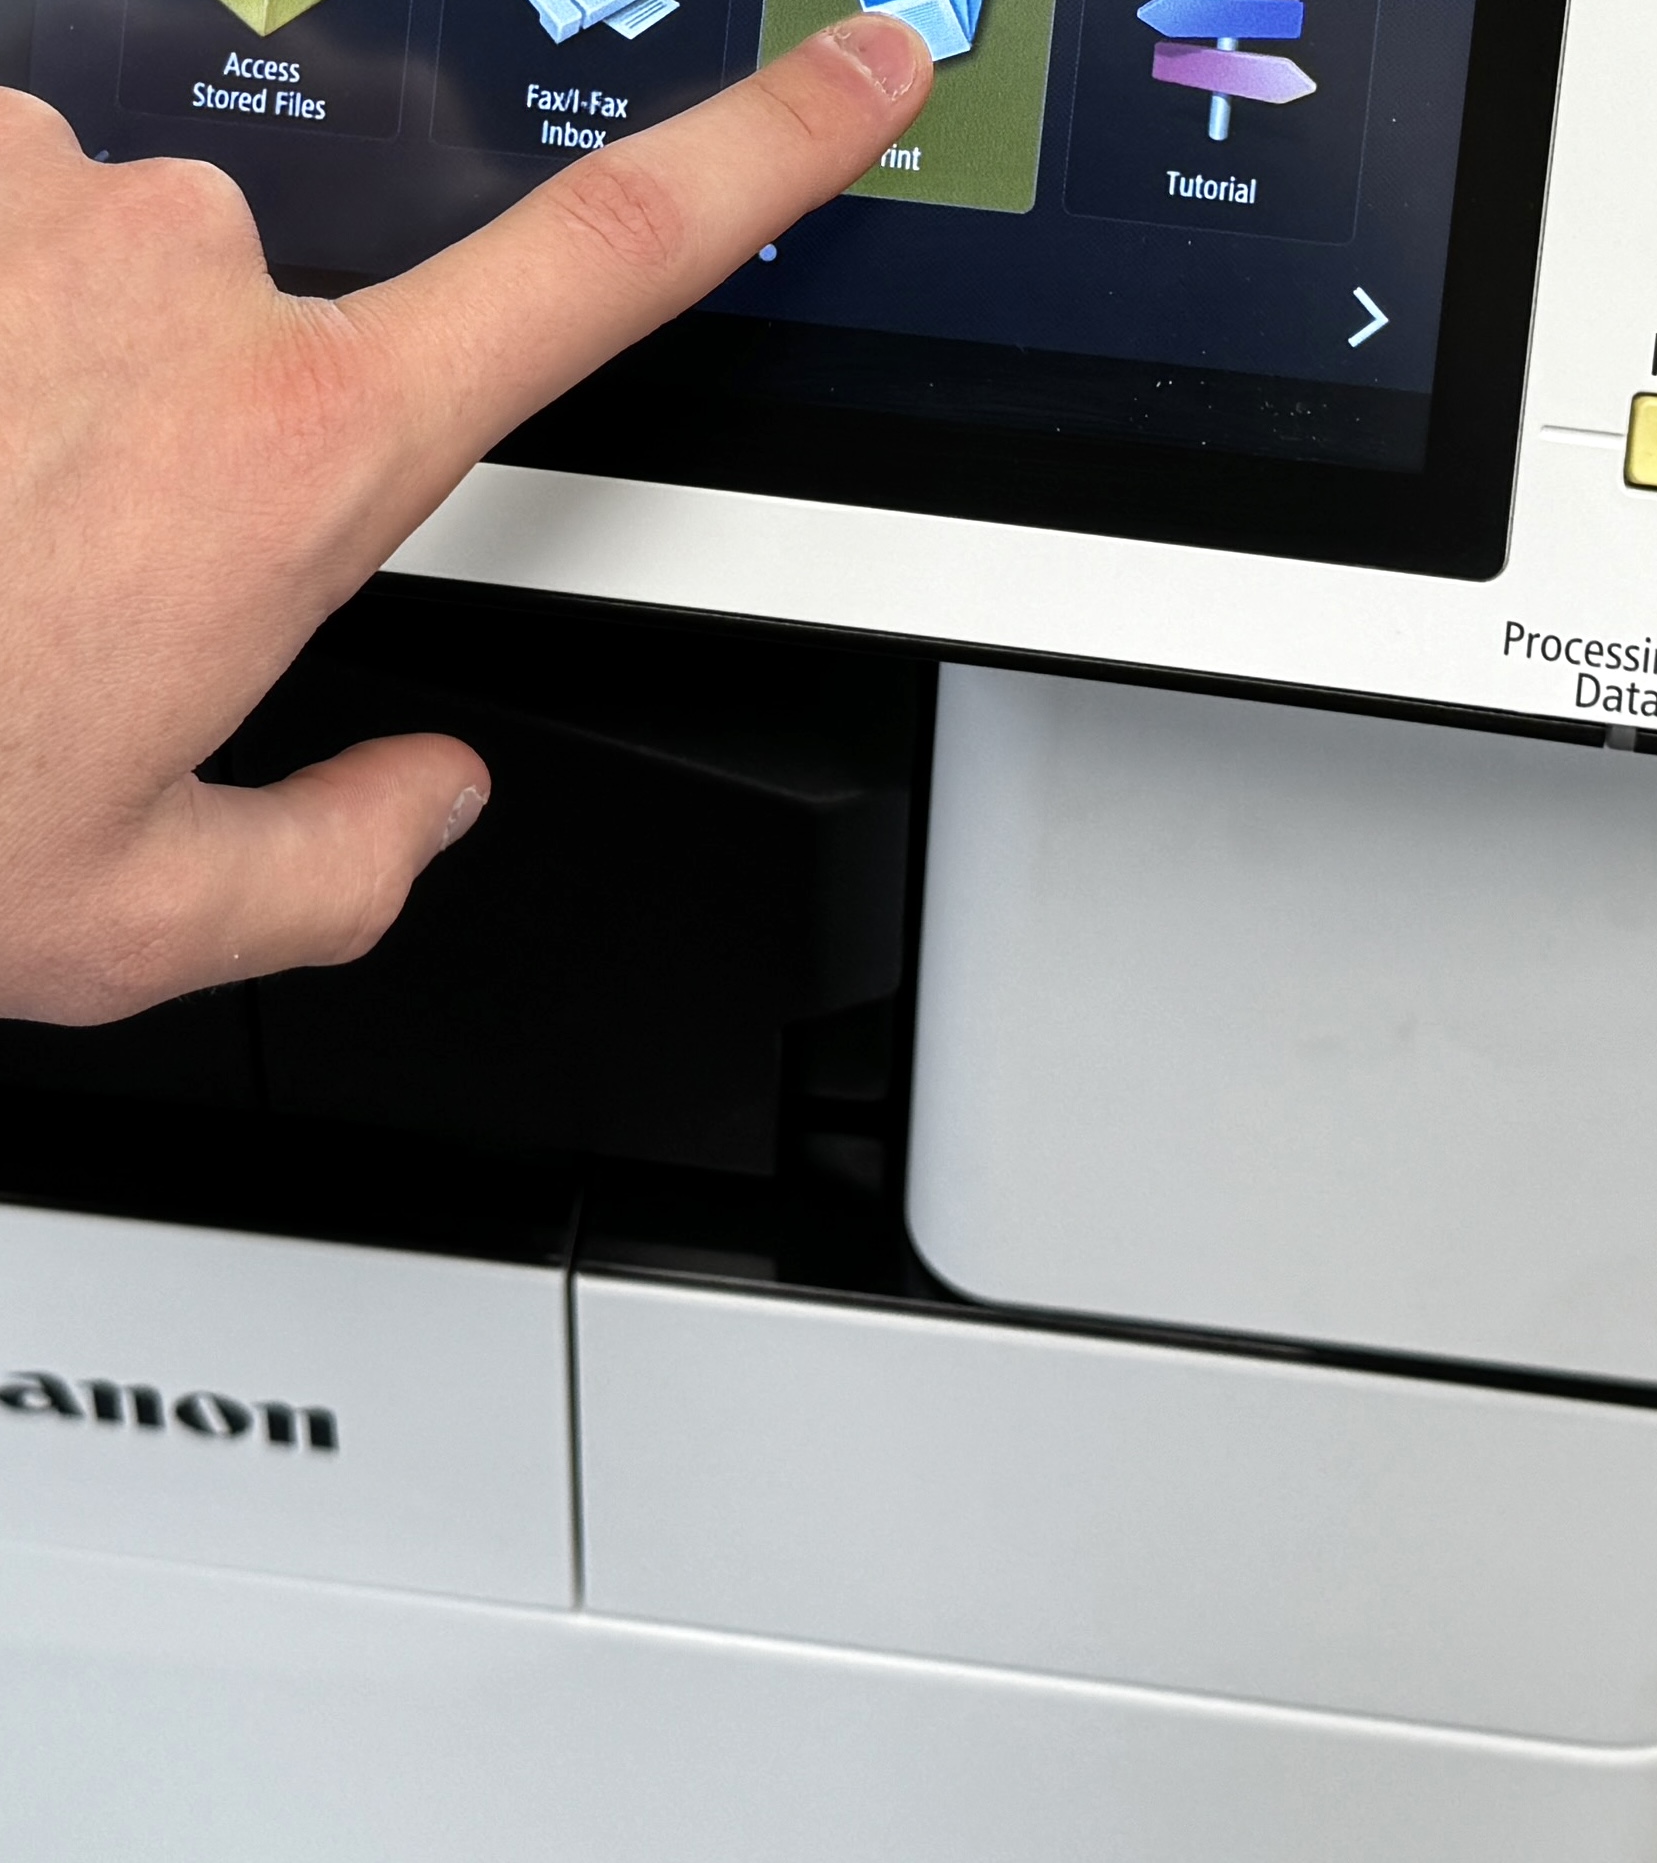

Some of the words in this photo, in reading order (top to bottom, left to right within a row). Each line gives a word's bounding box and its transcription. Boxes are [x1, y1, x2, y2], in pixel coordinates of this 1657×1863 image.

[223, 51, 301, 84] Access
[191, 82, 268, 116] Stored
[274, 89, 327, 121] Files
[526, 83, 629, 119] Fax/I-Fax
[541, 119, 607, 149] Inbox
[880, 143, 922, 171] rint
[1166, 170, 1257, 205] Tutorial
